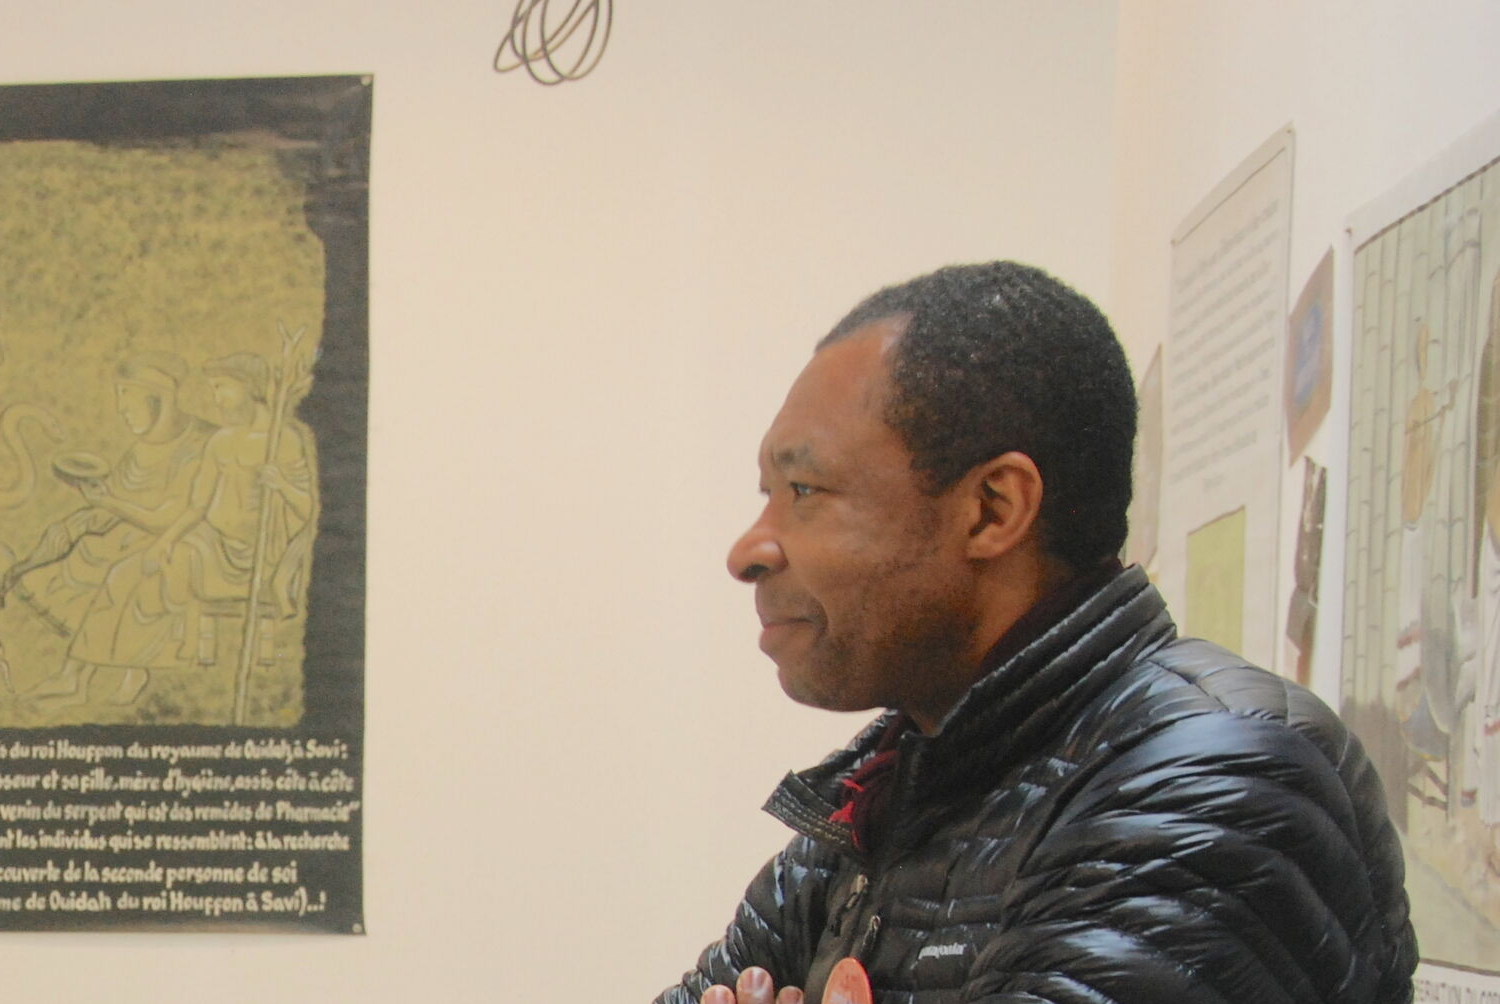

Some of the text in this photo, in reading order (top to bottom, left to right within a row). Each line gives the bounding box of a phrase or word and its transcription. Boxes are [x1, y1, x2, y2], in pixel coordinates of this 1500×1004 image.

[9, 741, 30, 759] du
[32, 740, 55, 759] roi
[127, 742, 149, 759] du
[151, 745, 222, 764] royaume
[224, 741, 243, 758] de
[42, 769, 59, 790] et
[61, 775, 79, 790] sa
[235, 768, 274, 790] assis
[0, 800, 41, 821] venin
[42, 801, 62, 820] du
[64, 801, 123, 826] serpent
[124, 801, 147, 825] qui
[147, 802, 168, 822] est
[168, 802, 193, 821] des
[255, 801, 273, 820] de
[16, 829, 38, 849] les
[39, 829, 107, 850] individus
[108, 830, 134, 853] qui
[133, 835, 153, 850] se
[266, 831, 282, 850] la
[282, 831, 349, 850] recherche
[63, 860, 81, 882] de
[84, 861, 100, 881] la
[101, 860, 163, 883] seconde
[166, 867, 245, 889] personne
[247, 861, 268, 883] de
[272, 860, 297, 883] soi
[25, 892, 46, 910] de
[49, 890, 112, 911] Ouidah
[117, 891, 140, 909] du
[142, 890, 167, 911] roi
